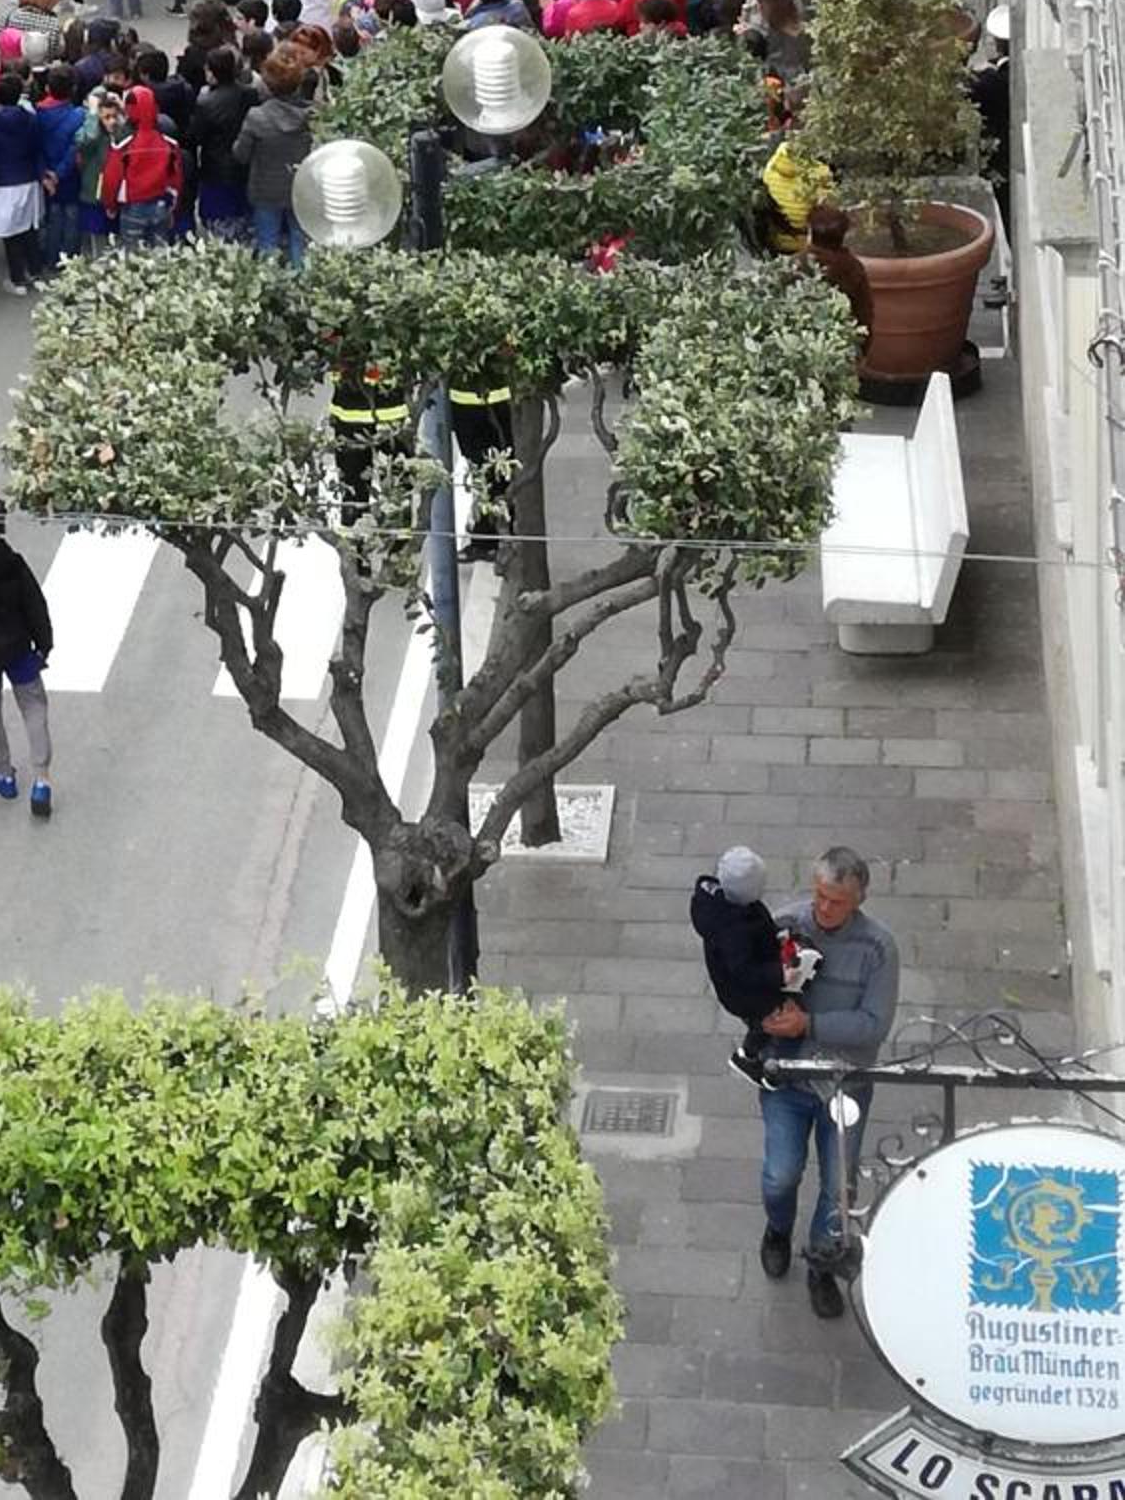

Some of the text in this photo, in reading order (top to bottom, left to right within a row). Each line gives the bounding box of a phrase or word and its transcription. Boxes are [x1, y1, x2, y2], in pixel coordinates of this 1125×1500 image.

[1067, 1264, 1109, 1296] W
[969, 1382, 1119, 1410] gegründet 1328
[891, 1438, 952, 1490] LO
